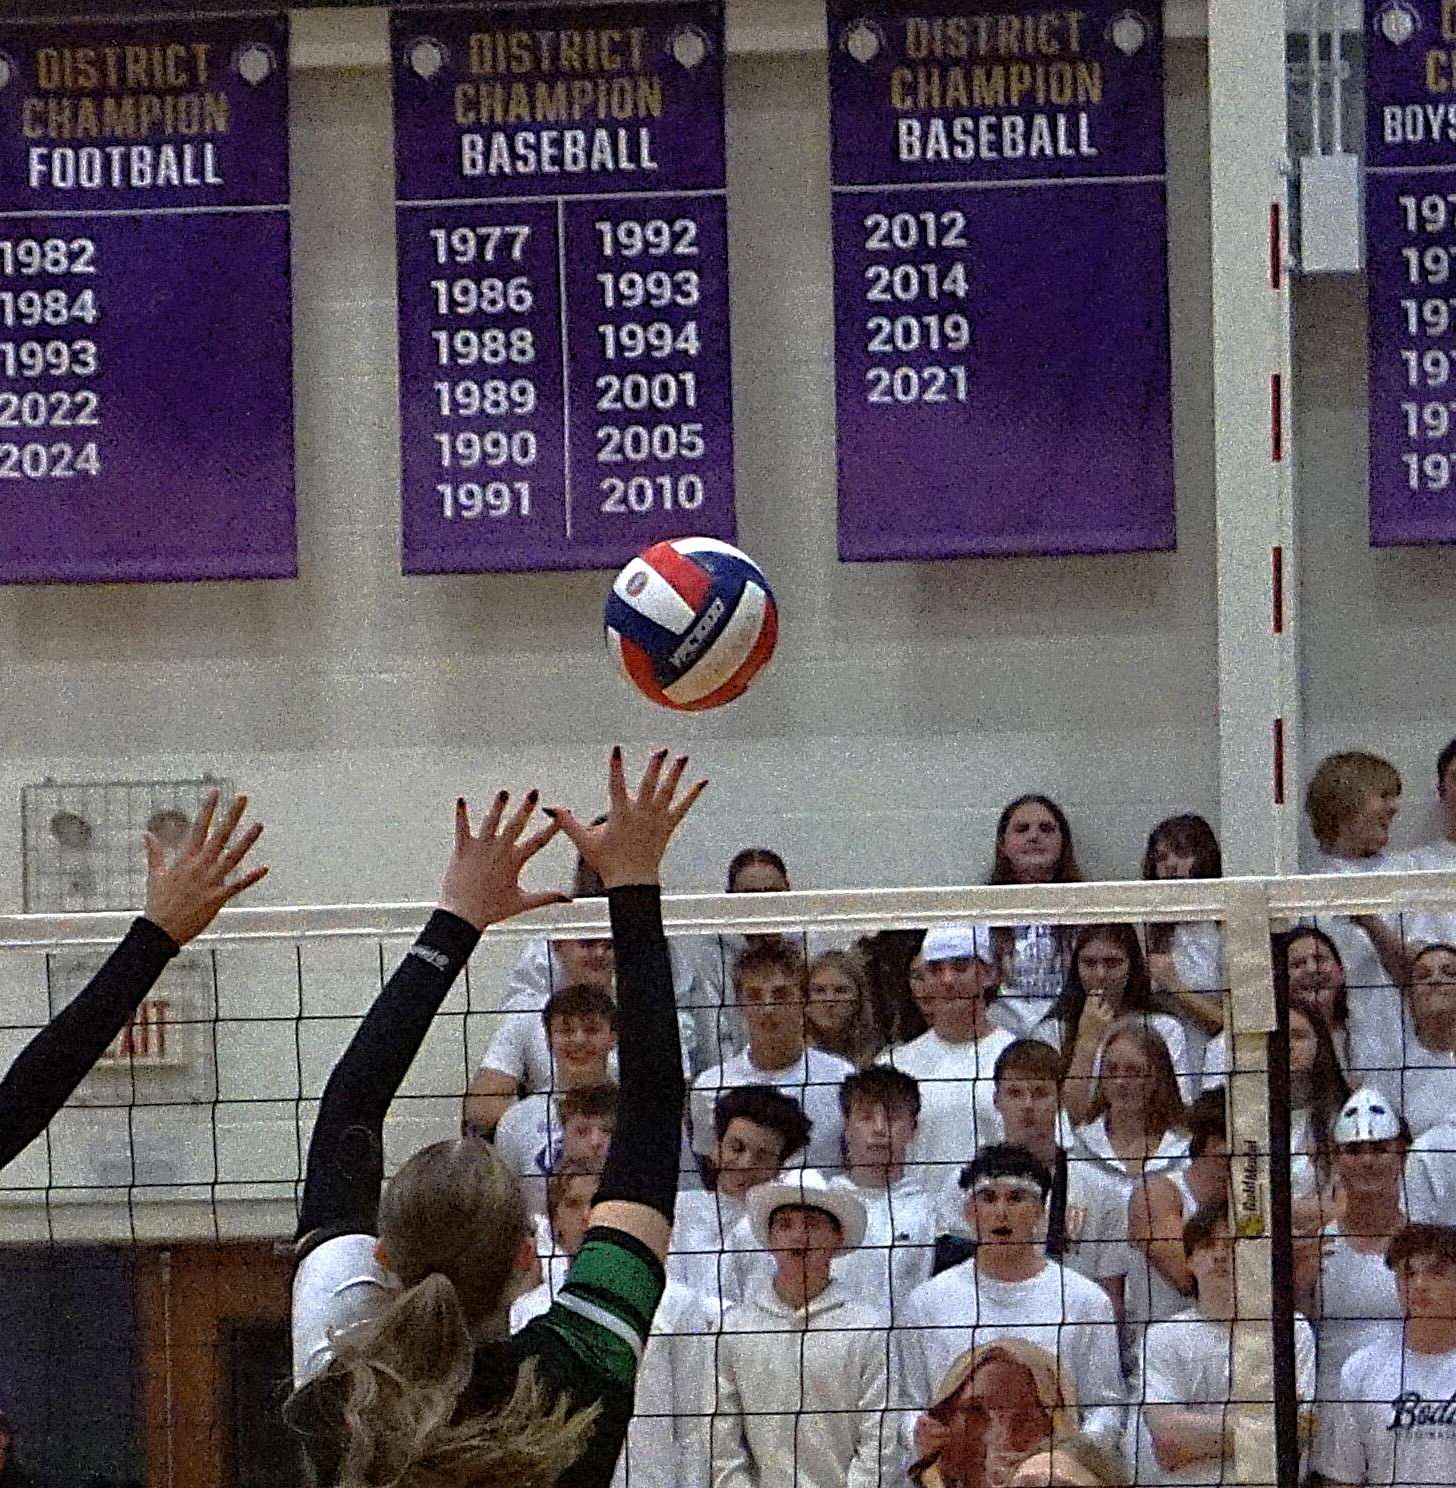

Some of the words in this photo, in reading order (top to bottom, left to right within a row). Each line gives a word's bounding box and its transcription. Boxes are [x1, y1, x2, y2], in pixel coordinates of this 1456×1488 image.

[469, 28, 643, 75] DISTRICT
[907, 11, 1083, 58] DISTRICT
[38, 44, 209, 89] DISTRICT
[456, 77, 661, 124] CHAMPION
[891, 63, 1101, 110] CHAMPION
[23, 92, 228, 138] CHAMPION
[462, 128, 657, 175] BASEBALL
[899, 113, 1096, 160] BASEBALL
[30, 143, 221, 188] FOOTBALL
[430, 226, 530, 263] 1977
[596, 220, 698, 256] 1992
[865, 211, 966, 250] 2012
[431, 277, 533, 314] 1986
[598, 271, 699, 307] 1993
[866, 263, 968, 300] 2014
[433, 329, 534, 365] 1988
[599, 322, 700, 358] 1994
[867, 315, 969, 352] 2019
[0, 340, 97, 376] 1993
[435, 380, 535, 416] 1989
[597, 372, 695, 409] 2001
[867, 366, 966, 402] 2021
[435, 431, 537, 467] 1990
[597, 424, 704, 461] 2005
[437, 482, 530, 518] 1991
[601, 475, 704, 512] 2010
